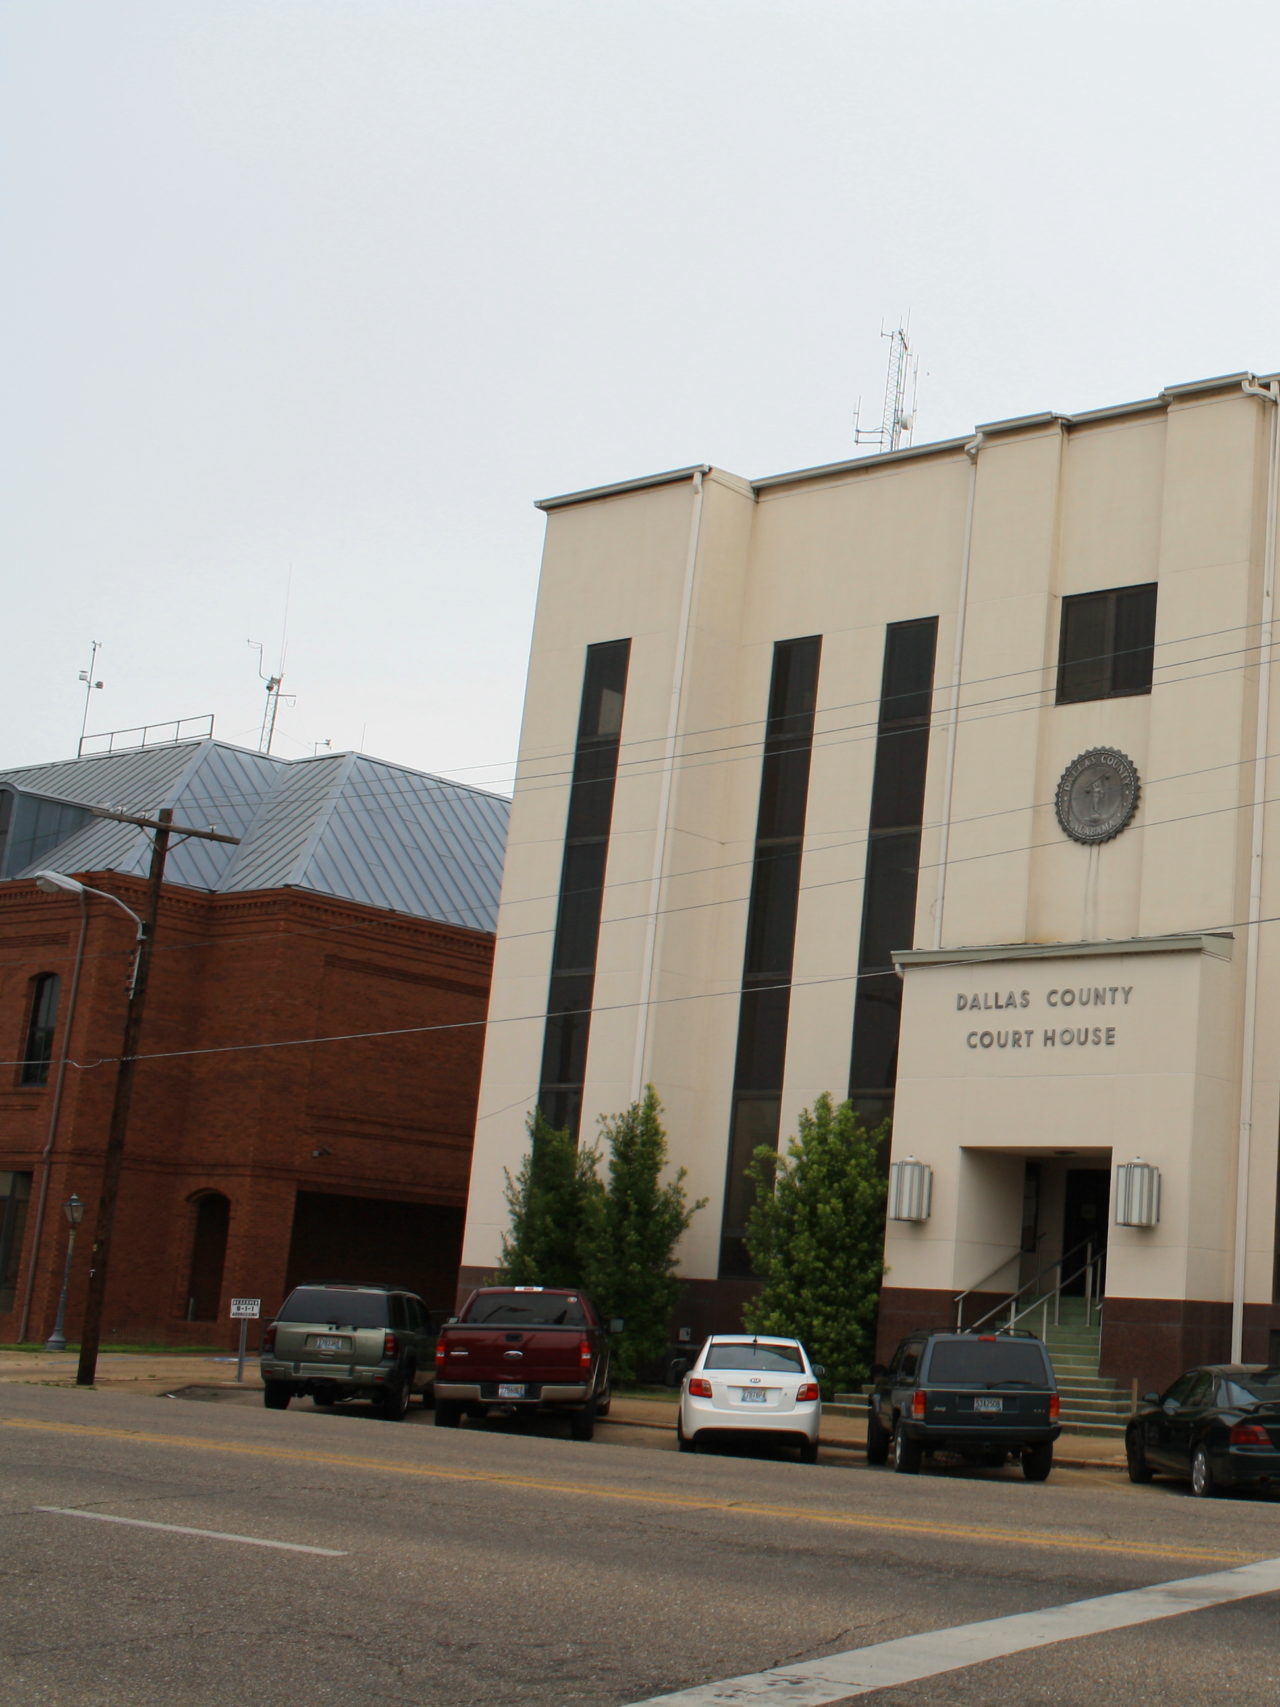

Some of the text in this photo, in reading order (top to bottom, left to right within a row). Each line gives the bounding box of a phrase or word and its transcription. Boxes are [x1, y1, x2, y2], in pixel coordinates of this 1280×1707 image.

[1101, 755, 1131, 785] COUNTY
[1073, 820, 1113, 836] ALABAMA
[956, 986, 1133, 1011] DALLAS COUNTY
[966, 1026, 1116, 1048] COURT HOUSE
